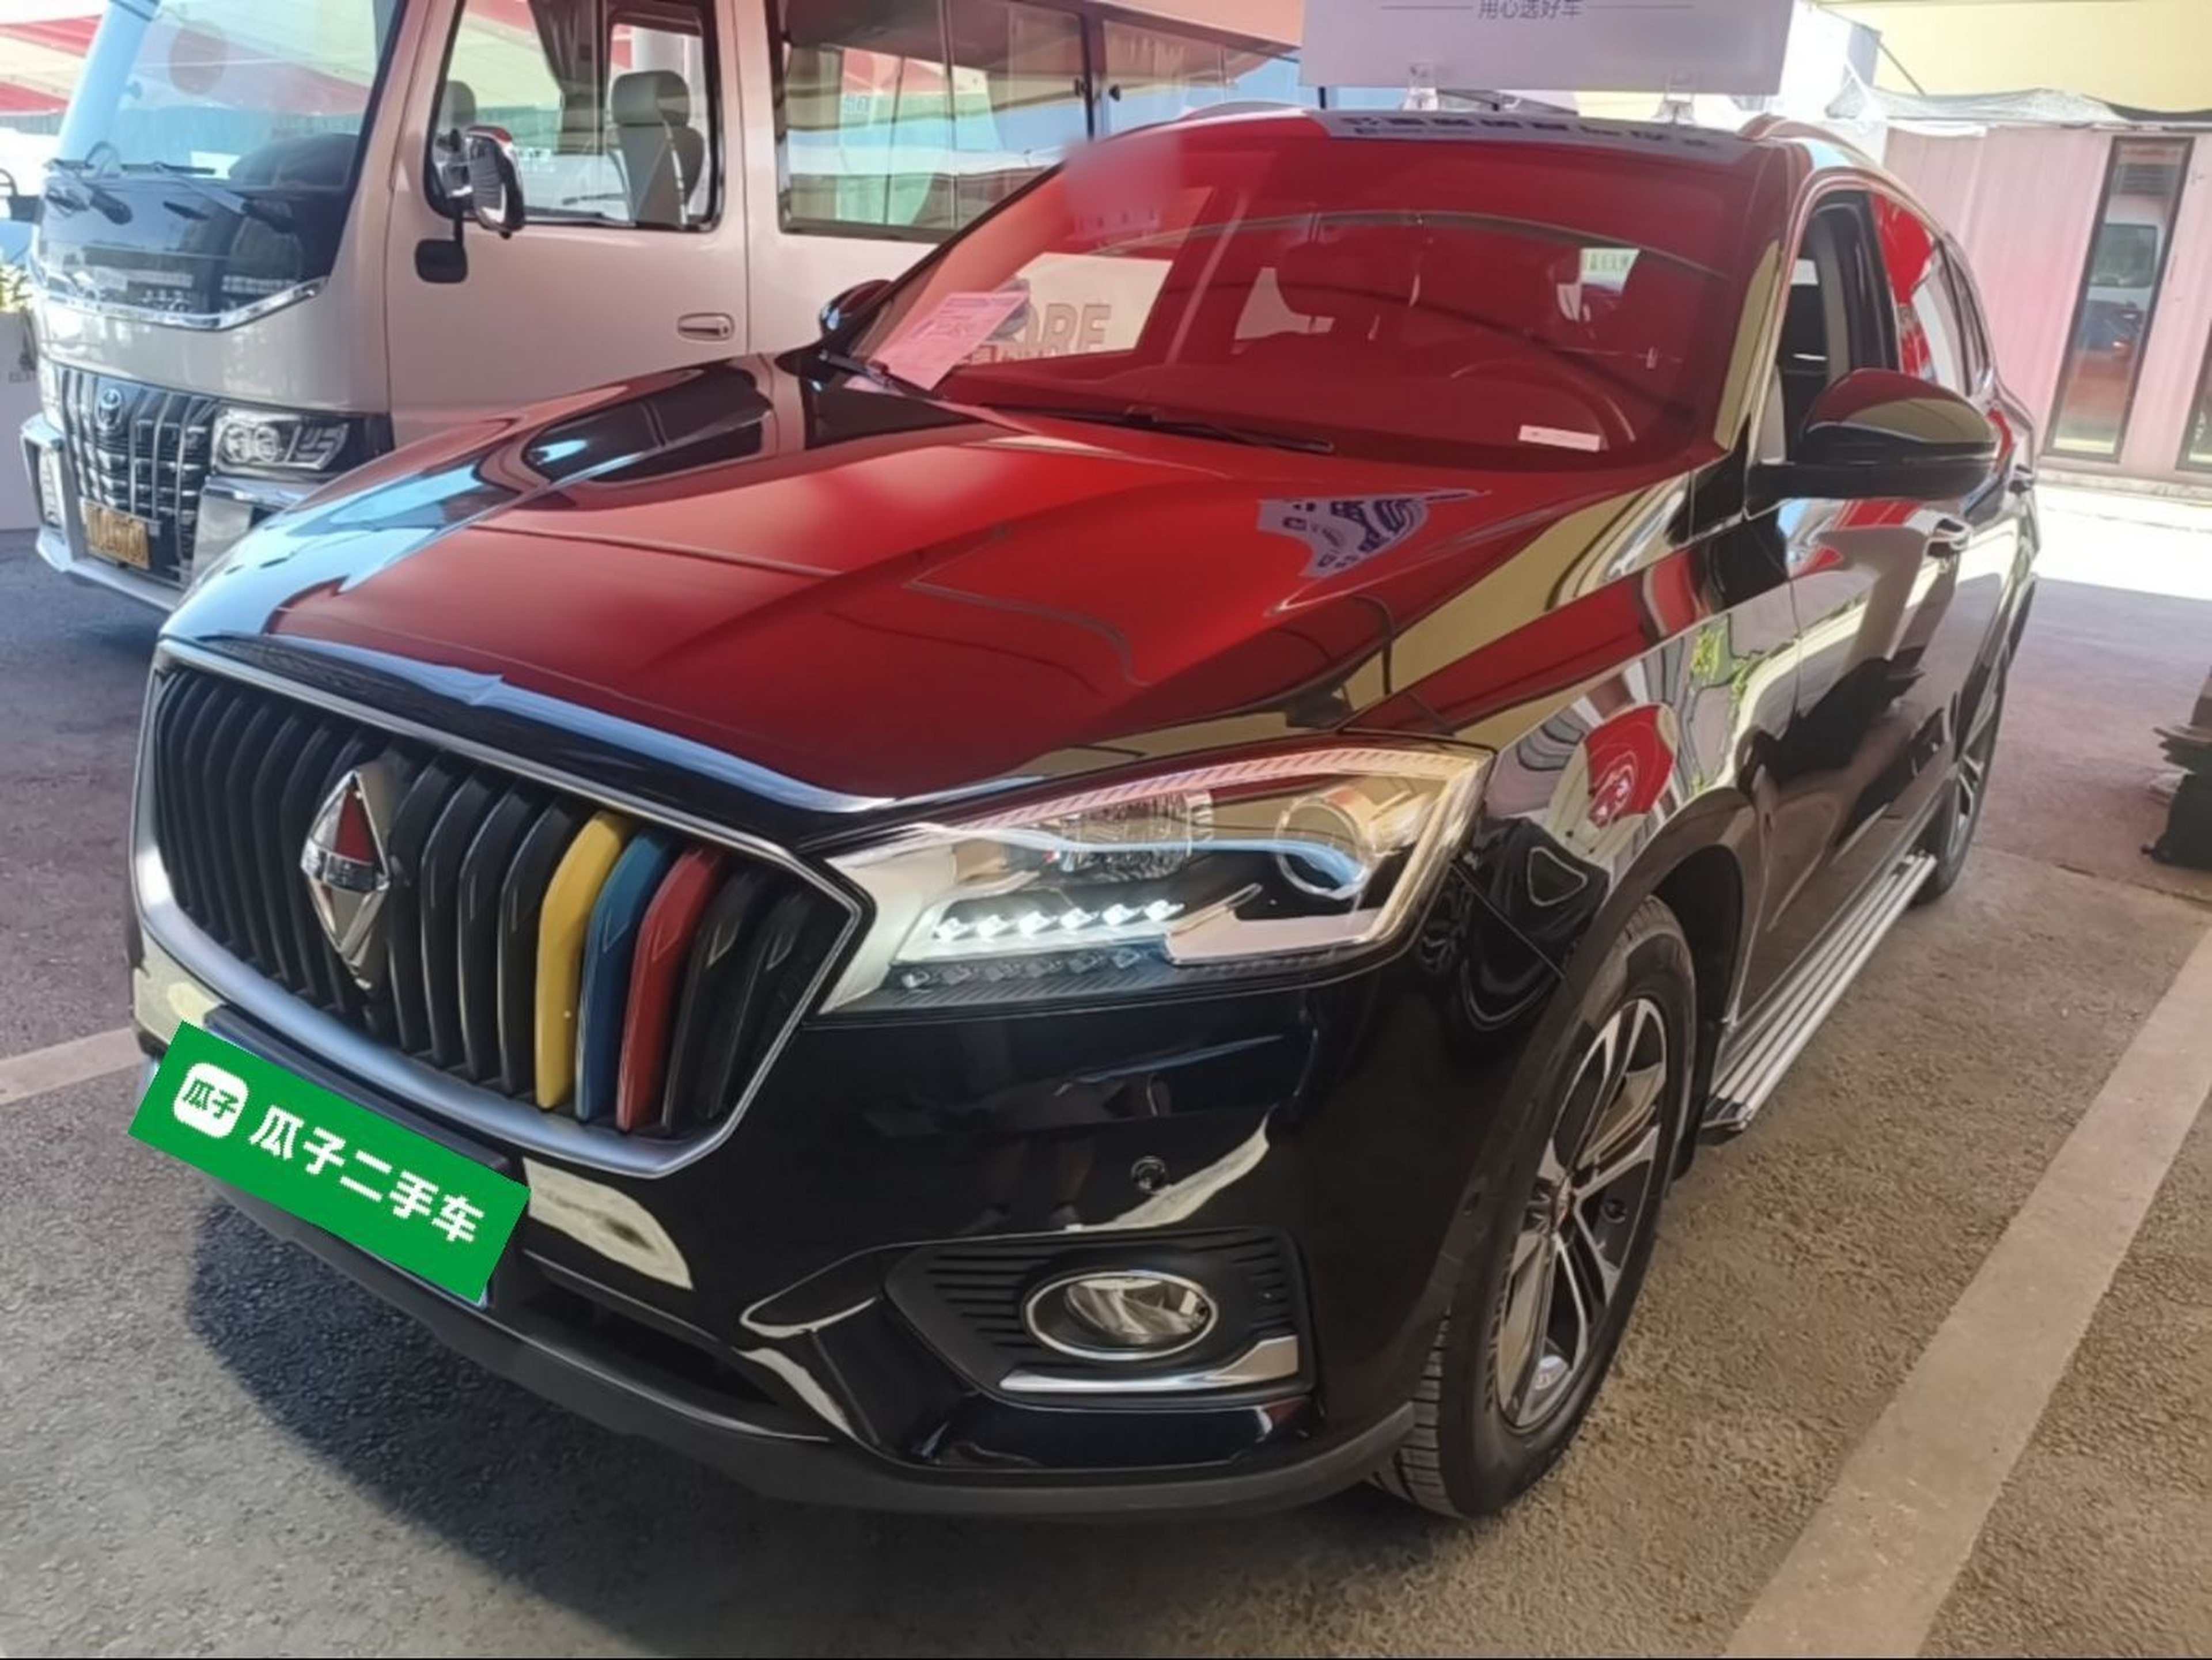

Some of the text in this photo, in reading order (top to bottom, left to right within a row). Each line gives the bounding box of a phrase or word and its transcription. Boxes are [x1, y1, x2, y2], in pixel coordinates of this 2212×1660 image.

[1478, 0, 1582, 20] 用心选好车
